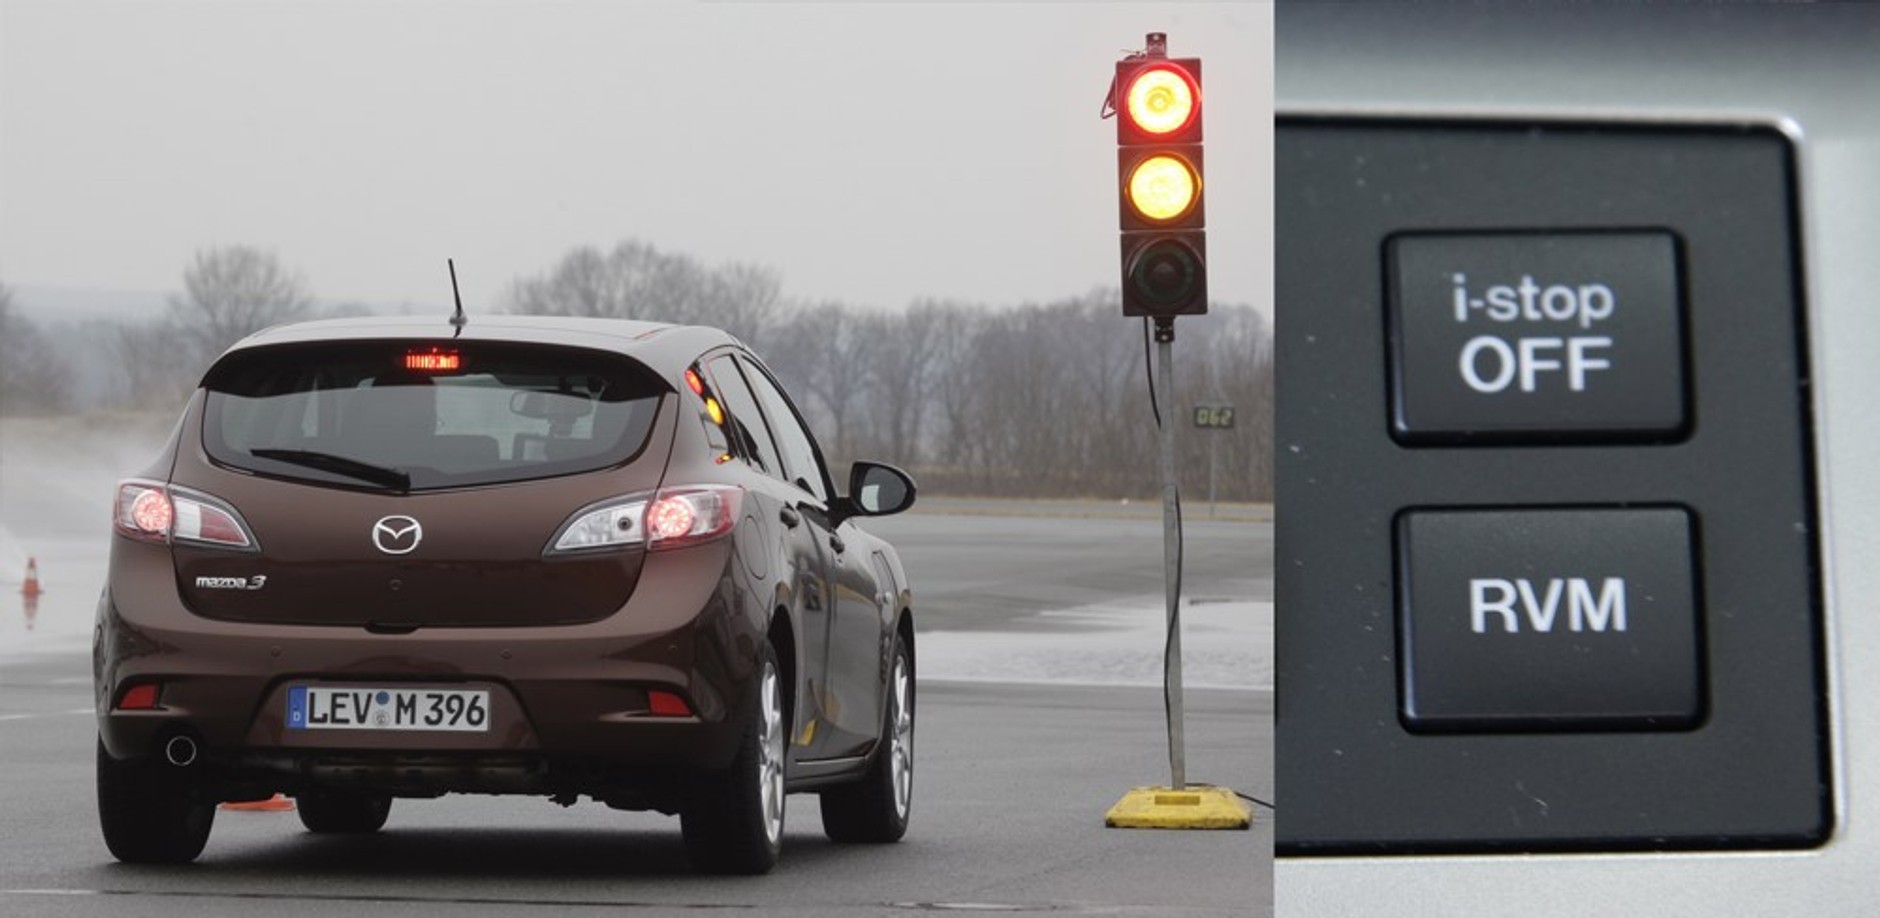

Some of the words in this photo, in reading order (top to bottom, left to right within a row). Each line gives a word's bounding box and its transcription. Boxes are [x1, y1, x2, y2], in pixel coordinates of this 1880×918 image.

[1452, 272, 1614, 328] i-stop
[1459, 335, 1613, 393] OFF
[1469, 577, 1628, 634] RVM
[308, 691, 373, 725] LEV
[395, 692, 417, 726] M
[423, 693, 486, 727] 396
